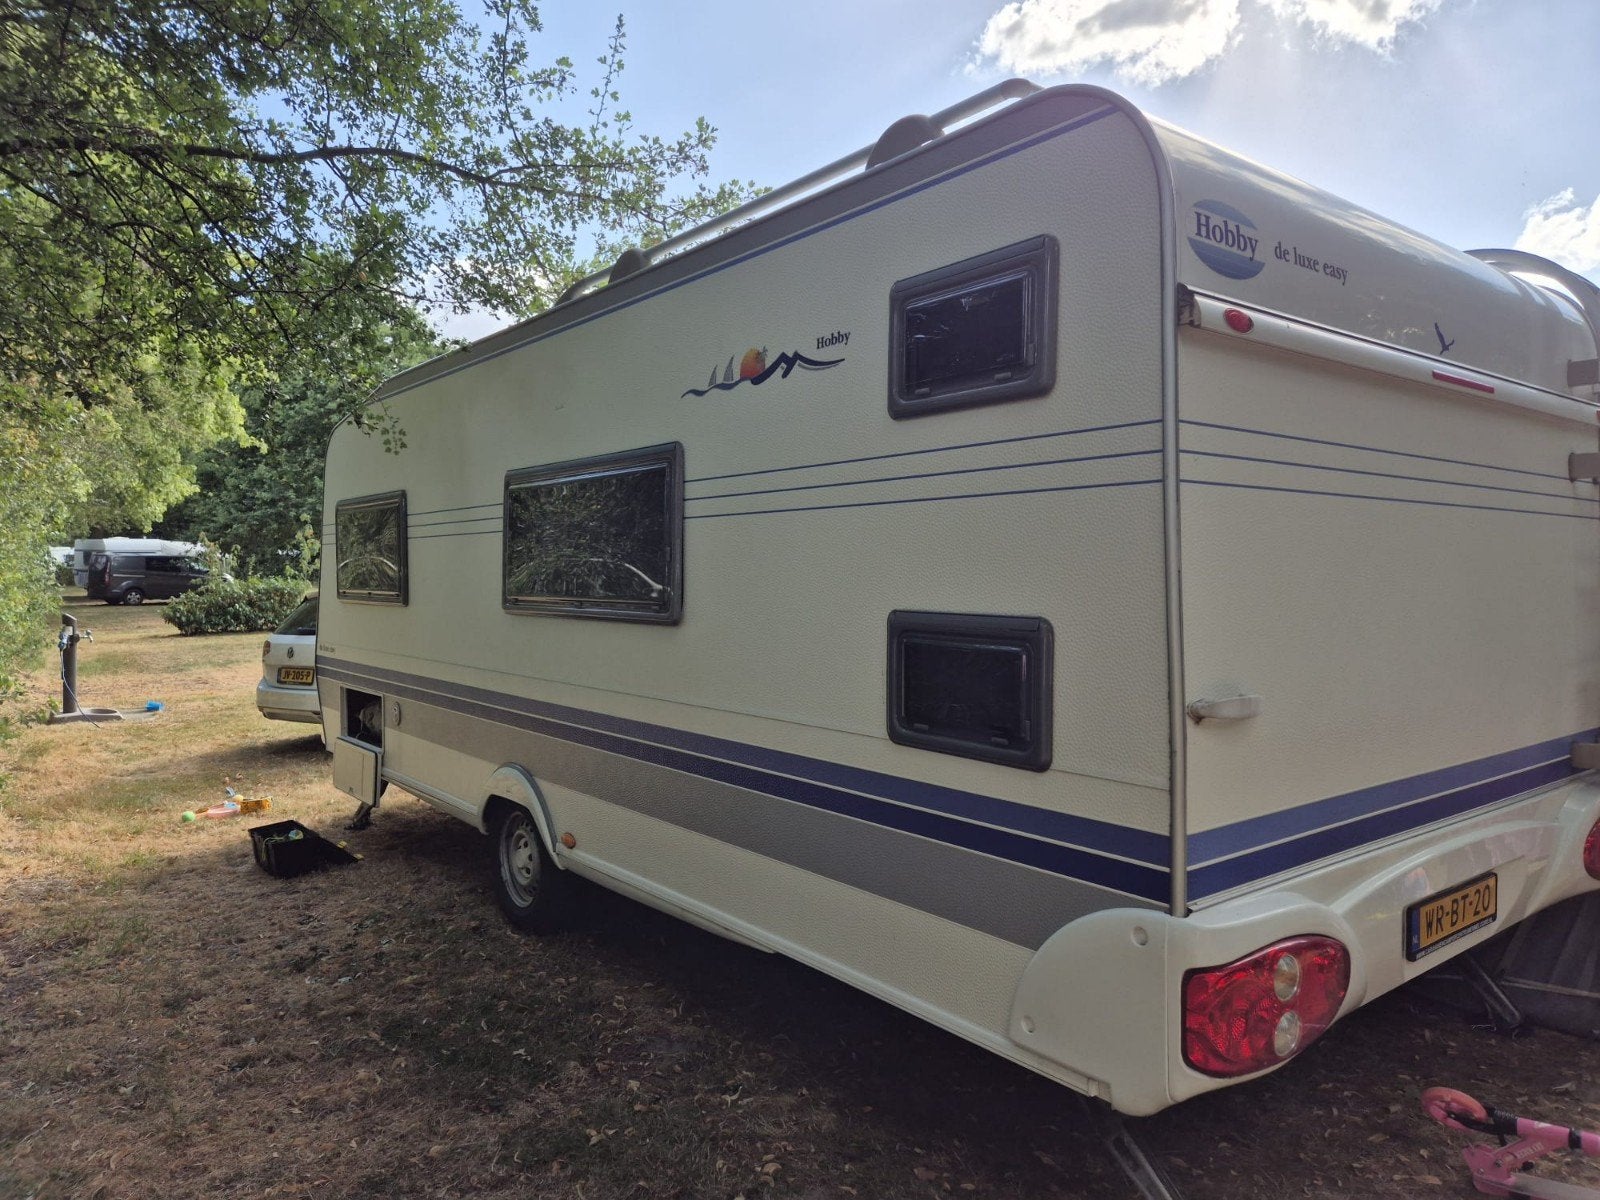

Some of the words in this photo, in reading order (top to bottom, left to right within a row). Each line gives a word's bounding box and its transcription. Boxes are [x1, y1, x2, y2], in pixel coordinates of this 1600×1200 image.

[1194, 211, 1258, 261] Hobby
[1274, 241, 1290, 262] de
[1294, 247, 1319, 272] luxe
[1322, 261, 1348, 285] easy
[816, 330, 851, 349] Hobby
[1425, 884, 1491, 939] WR-BT-20
